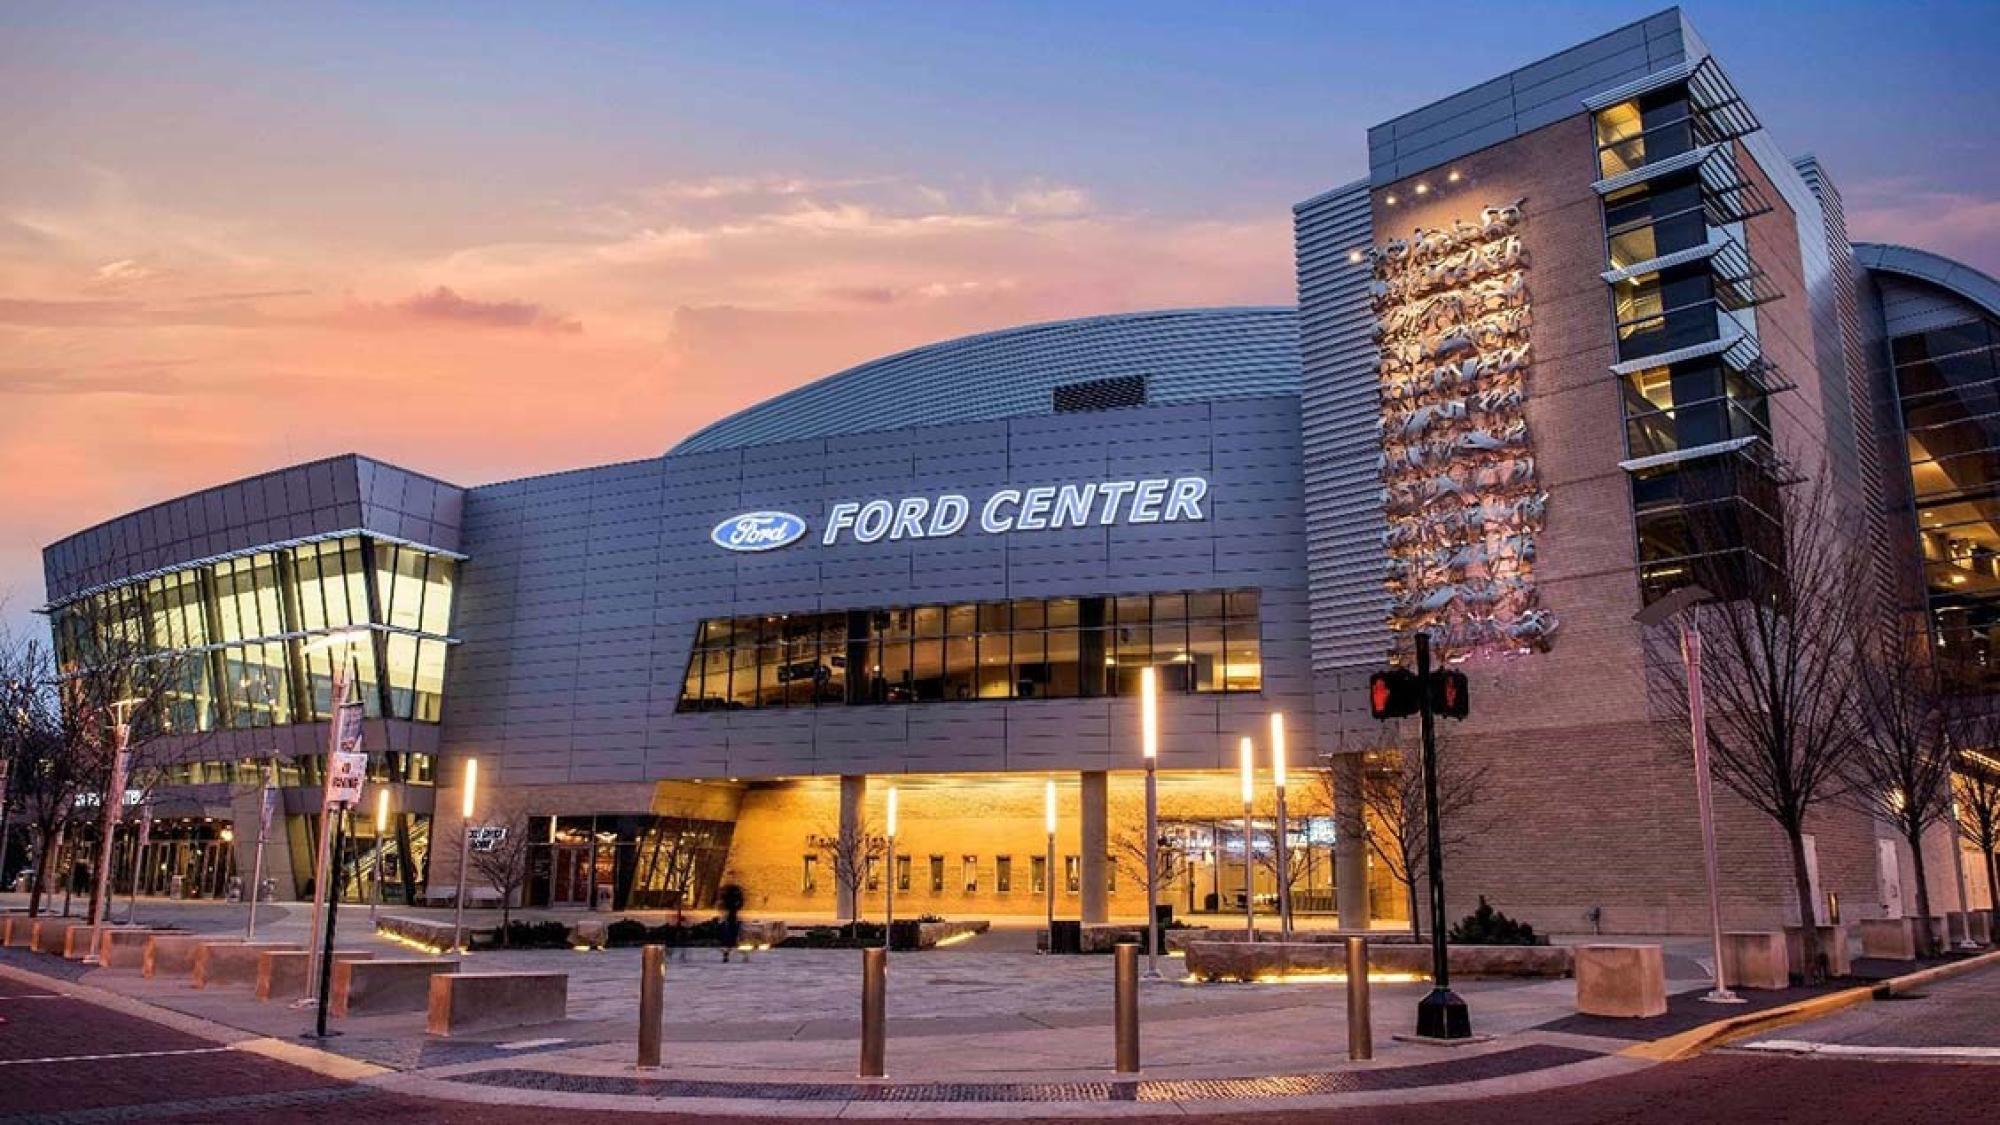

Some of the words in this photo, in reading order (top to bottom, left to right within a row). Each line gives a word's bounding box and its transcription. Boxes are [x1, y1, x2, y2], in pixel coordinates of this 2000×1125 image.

[730, 518, 789, 544] Ford
[822, 495, 968, 545] FORD
[981, 477, 1208, 532] CENTER
